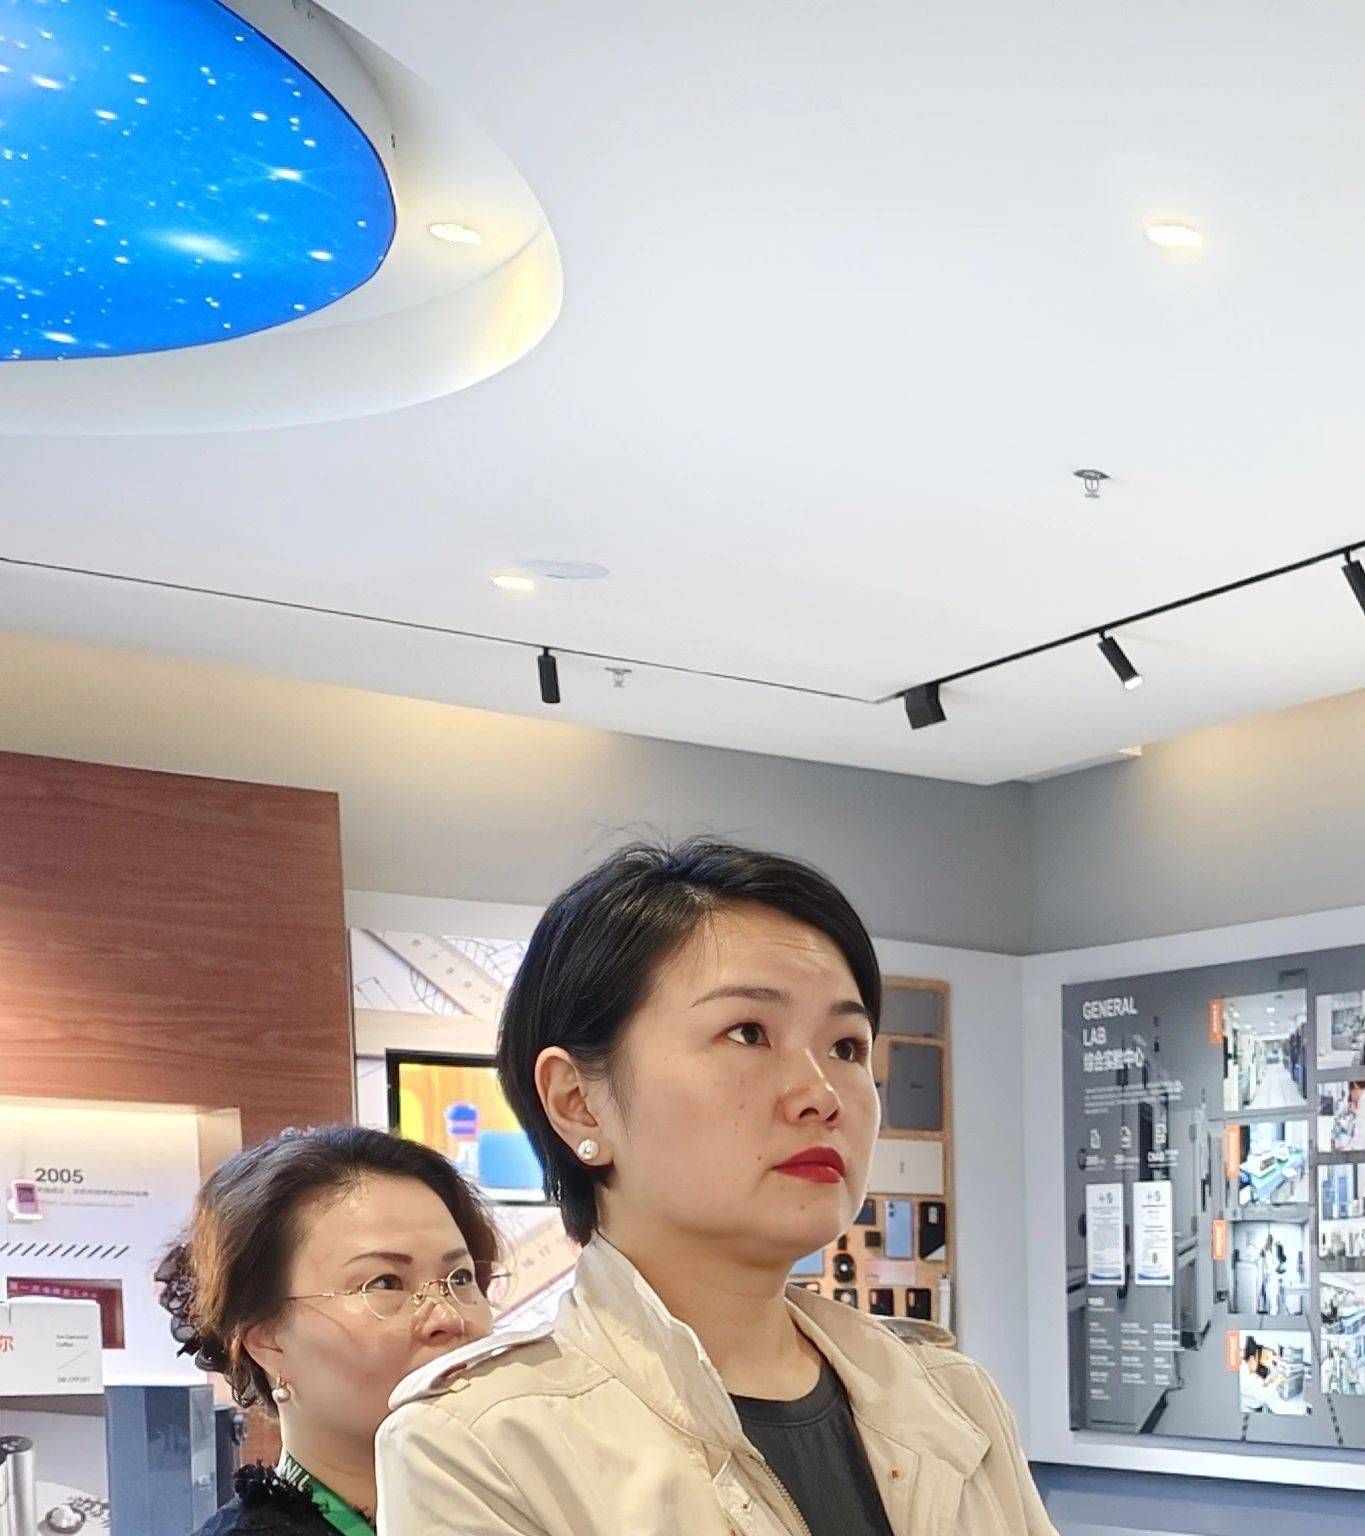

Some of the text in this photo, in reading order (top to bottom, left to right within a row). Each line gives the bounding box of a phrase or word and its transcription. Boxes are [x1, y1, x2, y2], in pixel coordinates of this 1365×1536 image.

[1083, 996, 1138, 1020] GENERAL
[1083, 1026, 1106, 1047] LAB
[35, 1168, 84, 1184] 2005
